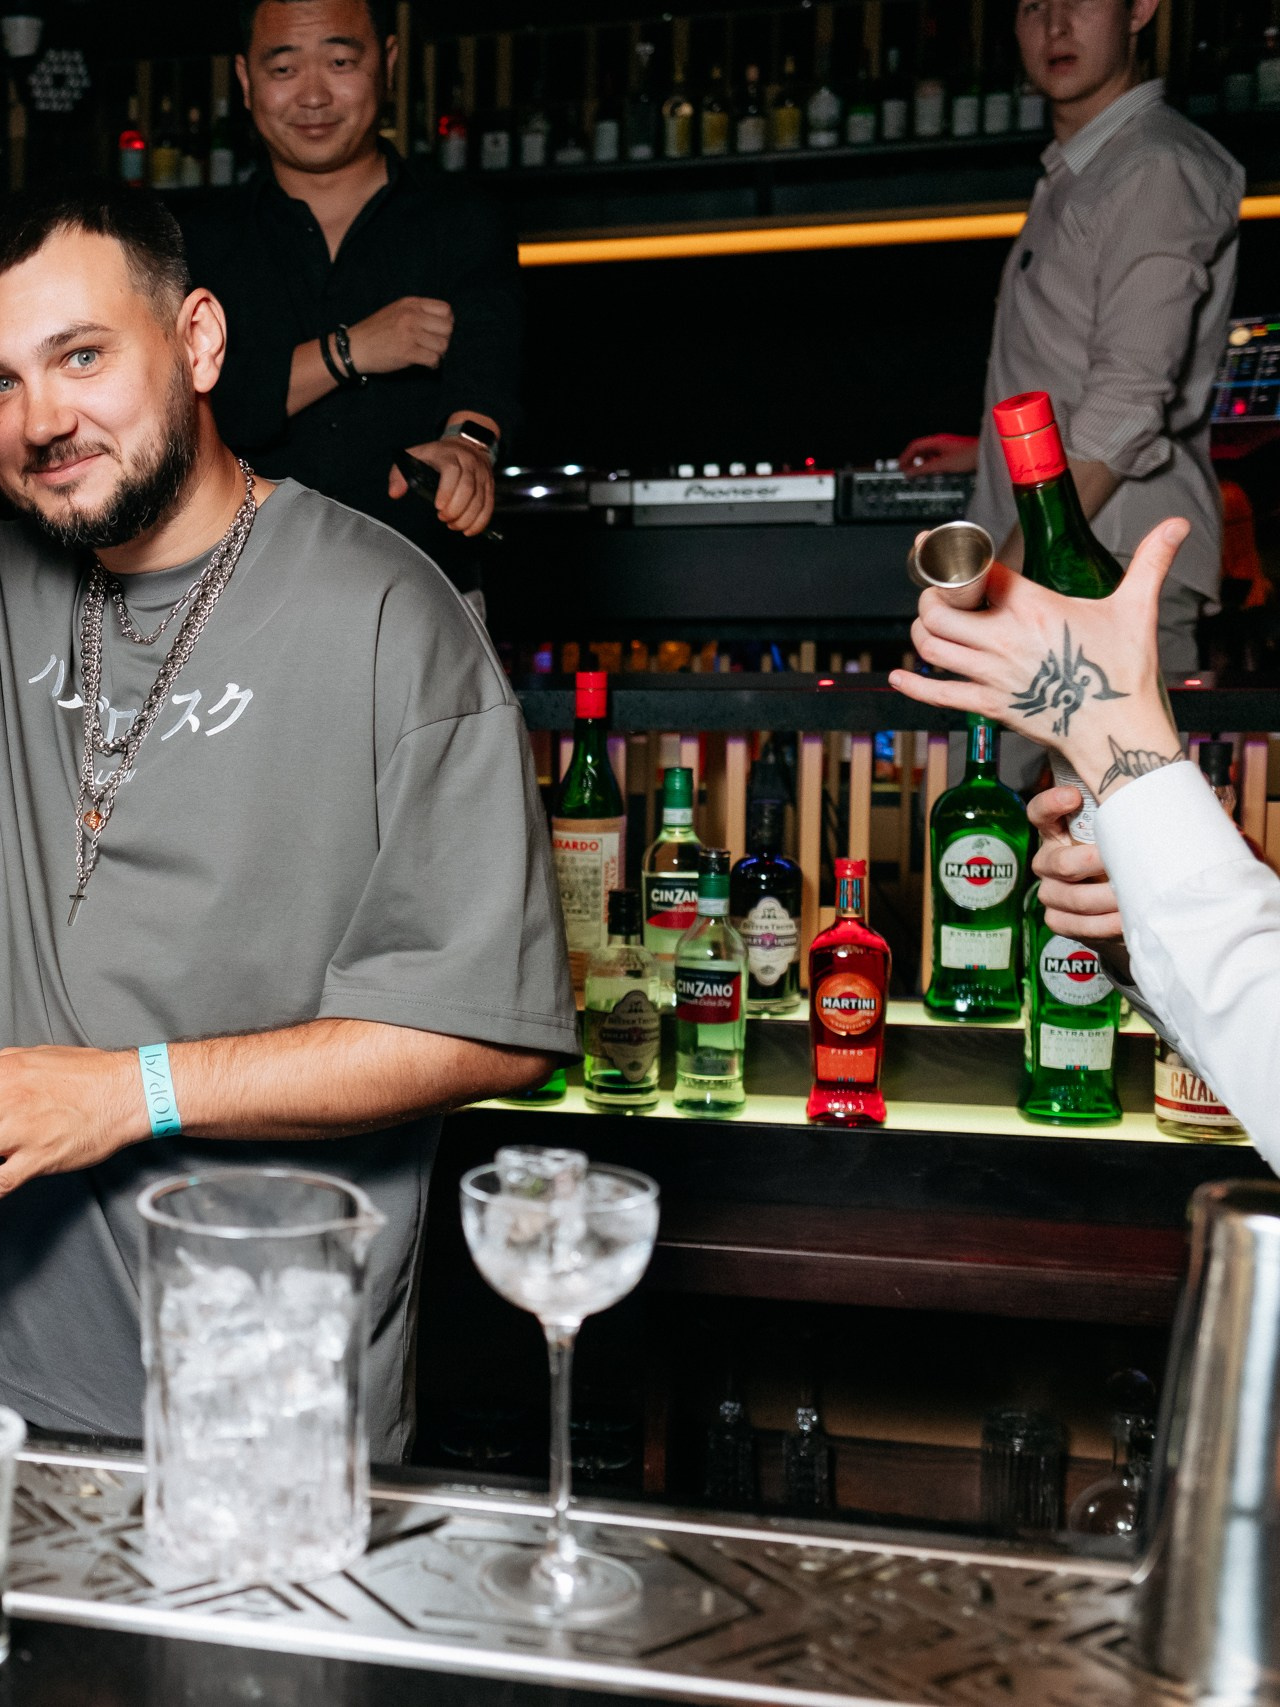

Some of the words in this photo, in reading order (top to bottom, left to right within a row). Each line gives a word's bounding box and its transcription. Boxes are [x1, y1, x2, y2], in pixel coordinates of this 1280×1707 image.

[684, 485, 780, 499] Pioneer
[946, 864, 1012, 878] MARTINI
[1047, 959, 1102, 973] MARTI
[676, 979, 734, 998] CINZANO
[822, 997, 875, 1010] MARTINI
[1088, 1030, 1107, 1038] DRY
[831, 1048, 864, 1056] FIERO
